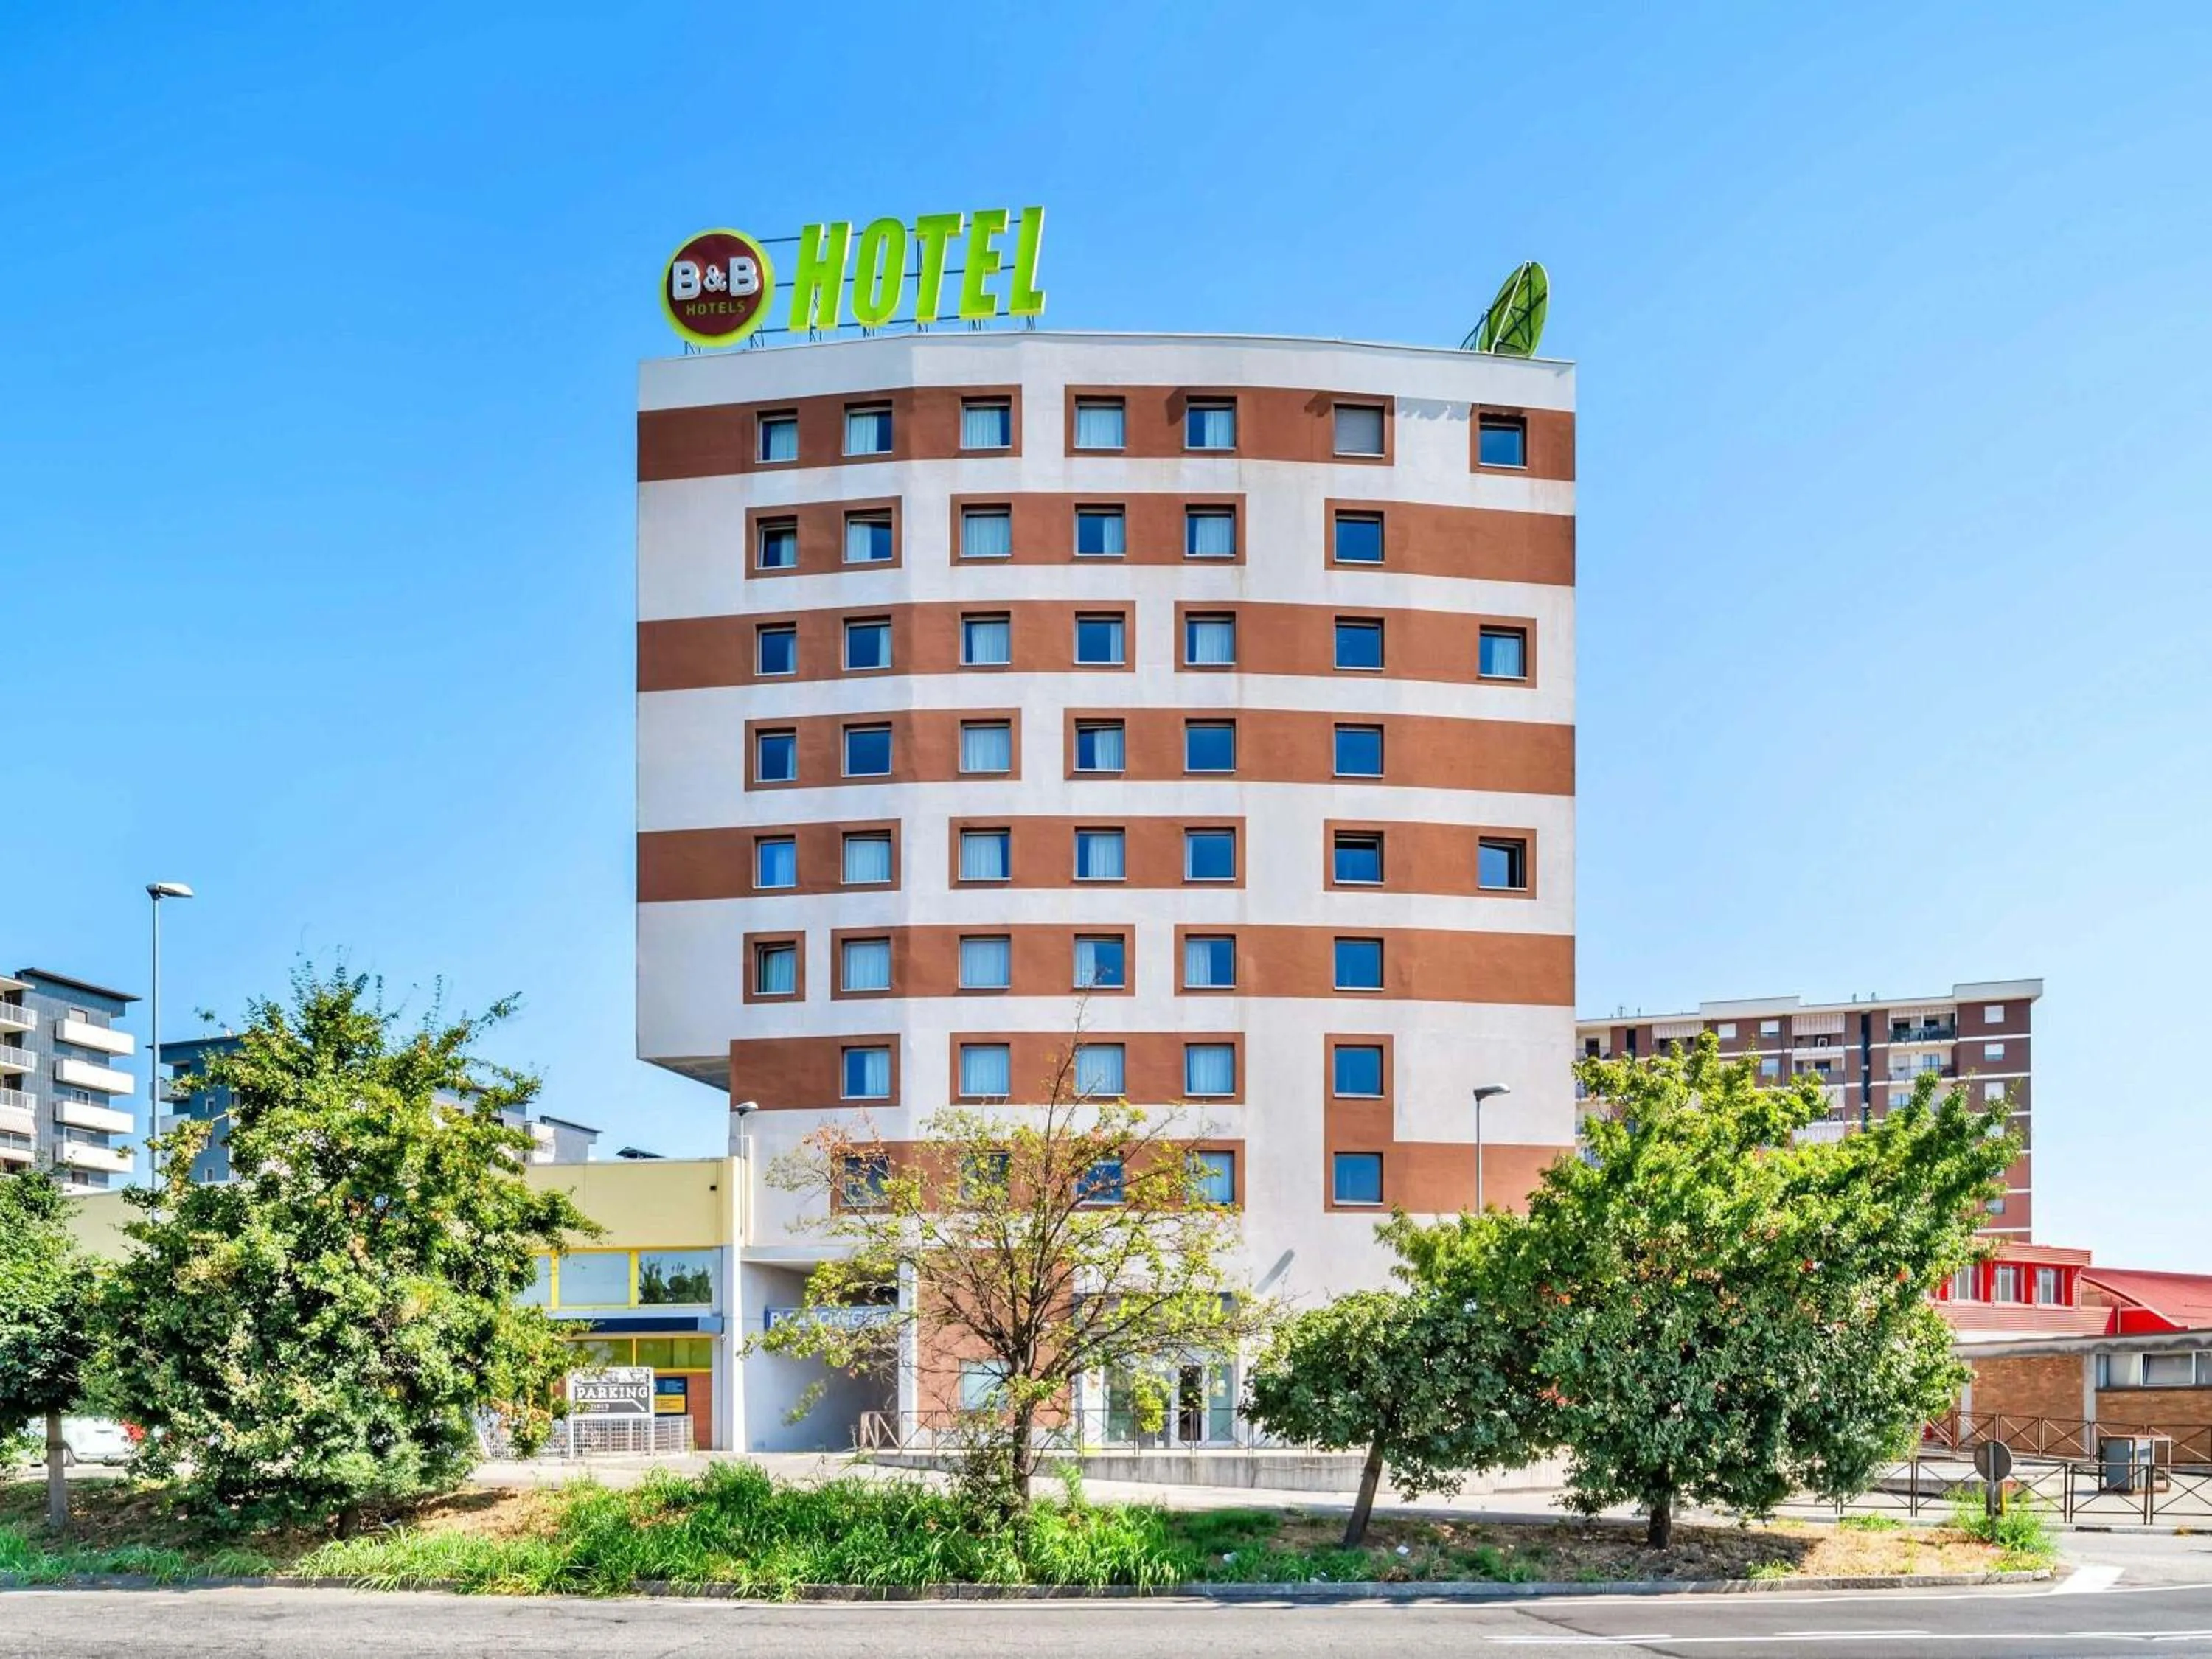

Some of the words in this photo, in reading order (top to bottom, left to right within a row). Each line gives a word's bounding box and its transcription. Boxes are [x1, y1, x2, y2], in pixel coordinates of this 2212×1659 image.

[672, 256, 759, 301] B&B
[789, 206, 1044, 331] HOTEL
[686, 301, 745, 316] HOTELS
[576, 1385, 648, 1399] PARKING
